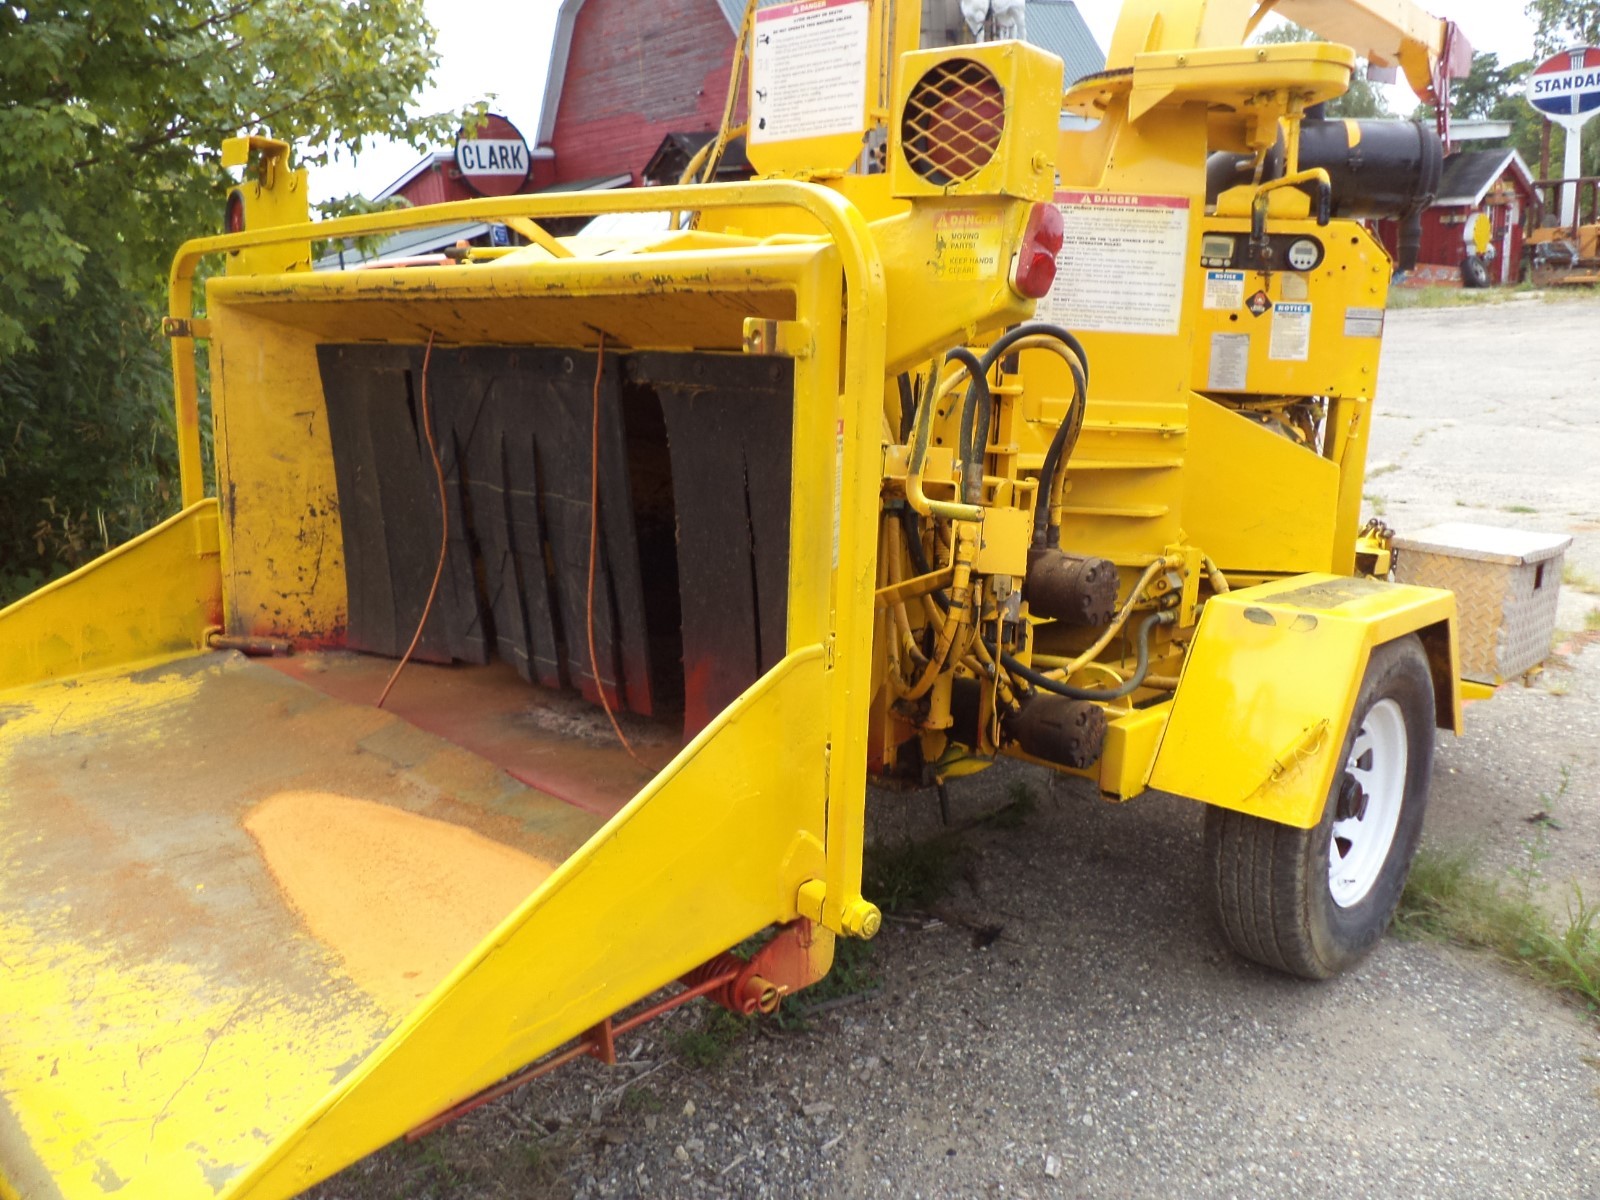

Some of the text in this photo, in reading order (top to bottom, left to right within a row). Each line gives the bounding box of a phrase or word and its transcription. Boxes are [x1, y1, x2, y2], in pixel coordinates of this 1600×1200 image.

[462, 145, 523, 170] CLARK
[1094, 195, 1138, 204] DANGER
[950, 215, 998, 224] DANGER
[952, 232, 979, 240] MOVING
